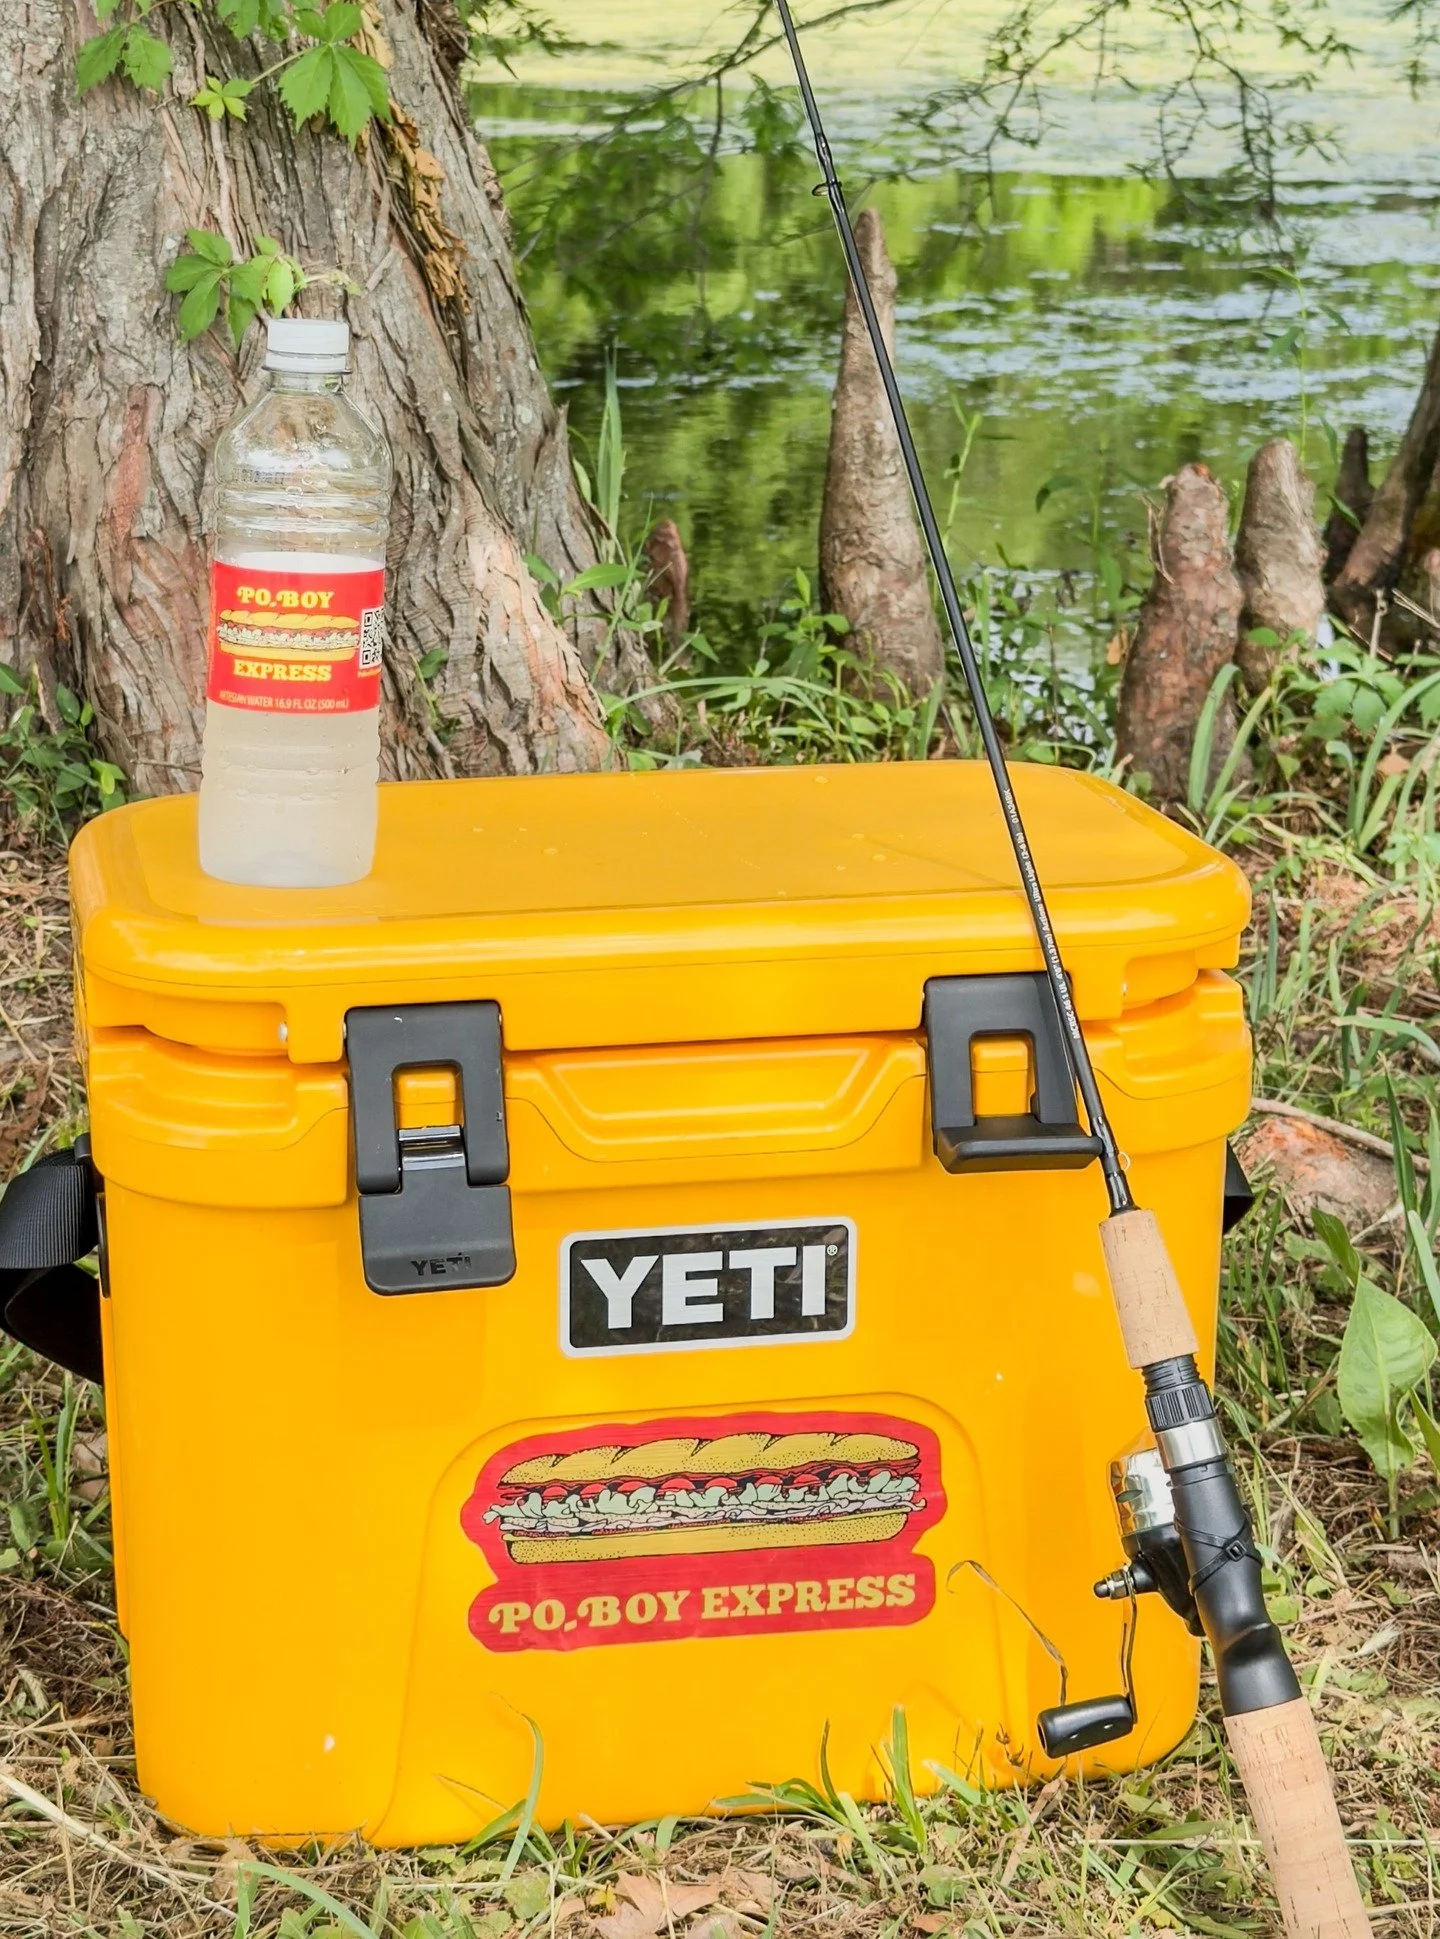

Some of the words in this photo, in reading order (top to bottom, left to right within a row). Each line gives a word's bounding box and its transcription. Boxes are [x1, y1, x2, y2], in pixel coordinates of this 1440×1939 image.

[234, 659, 332, 682] EXPRESS
[247, 695, 273, 707] WATER
[275, 698, 292, 709] 16.9
[293, 698, 303, 709] FL
[304, 698, 317, 710] OZ
[318, 698, 335, 711] (500
[1024, 860, 1036, 882] Light
[1029, 881, 1041, 902] Ultra
[702, 1574, 916, 1619] EXPRESS
